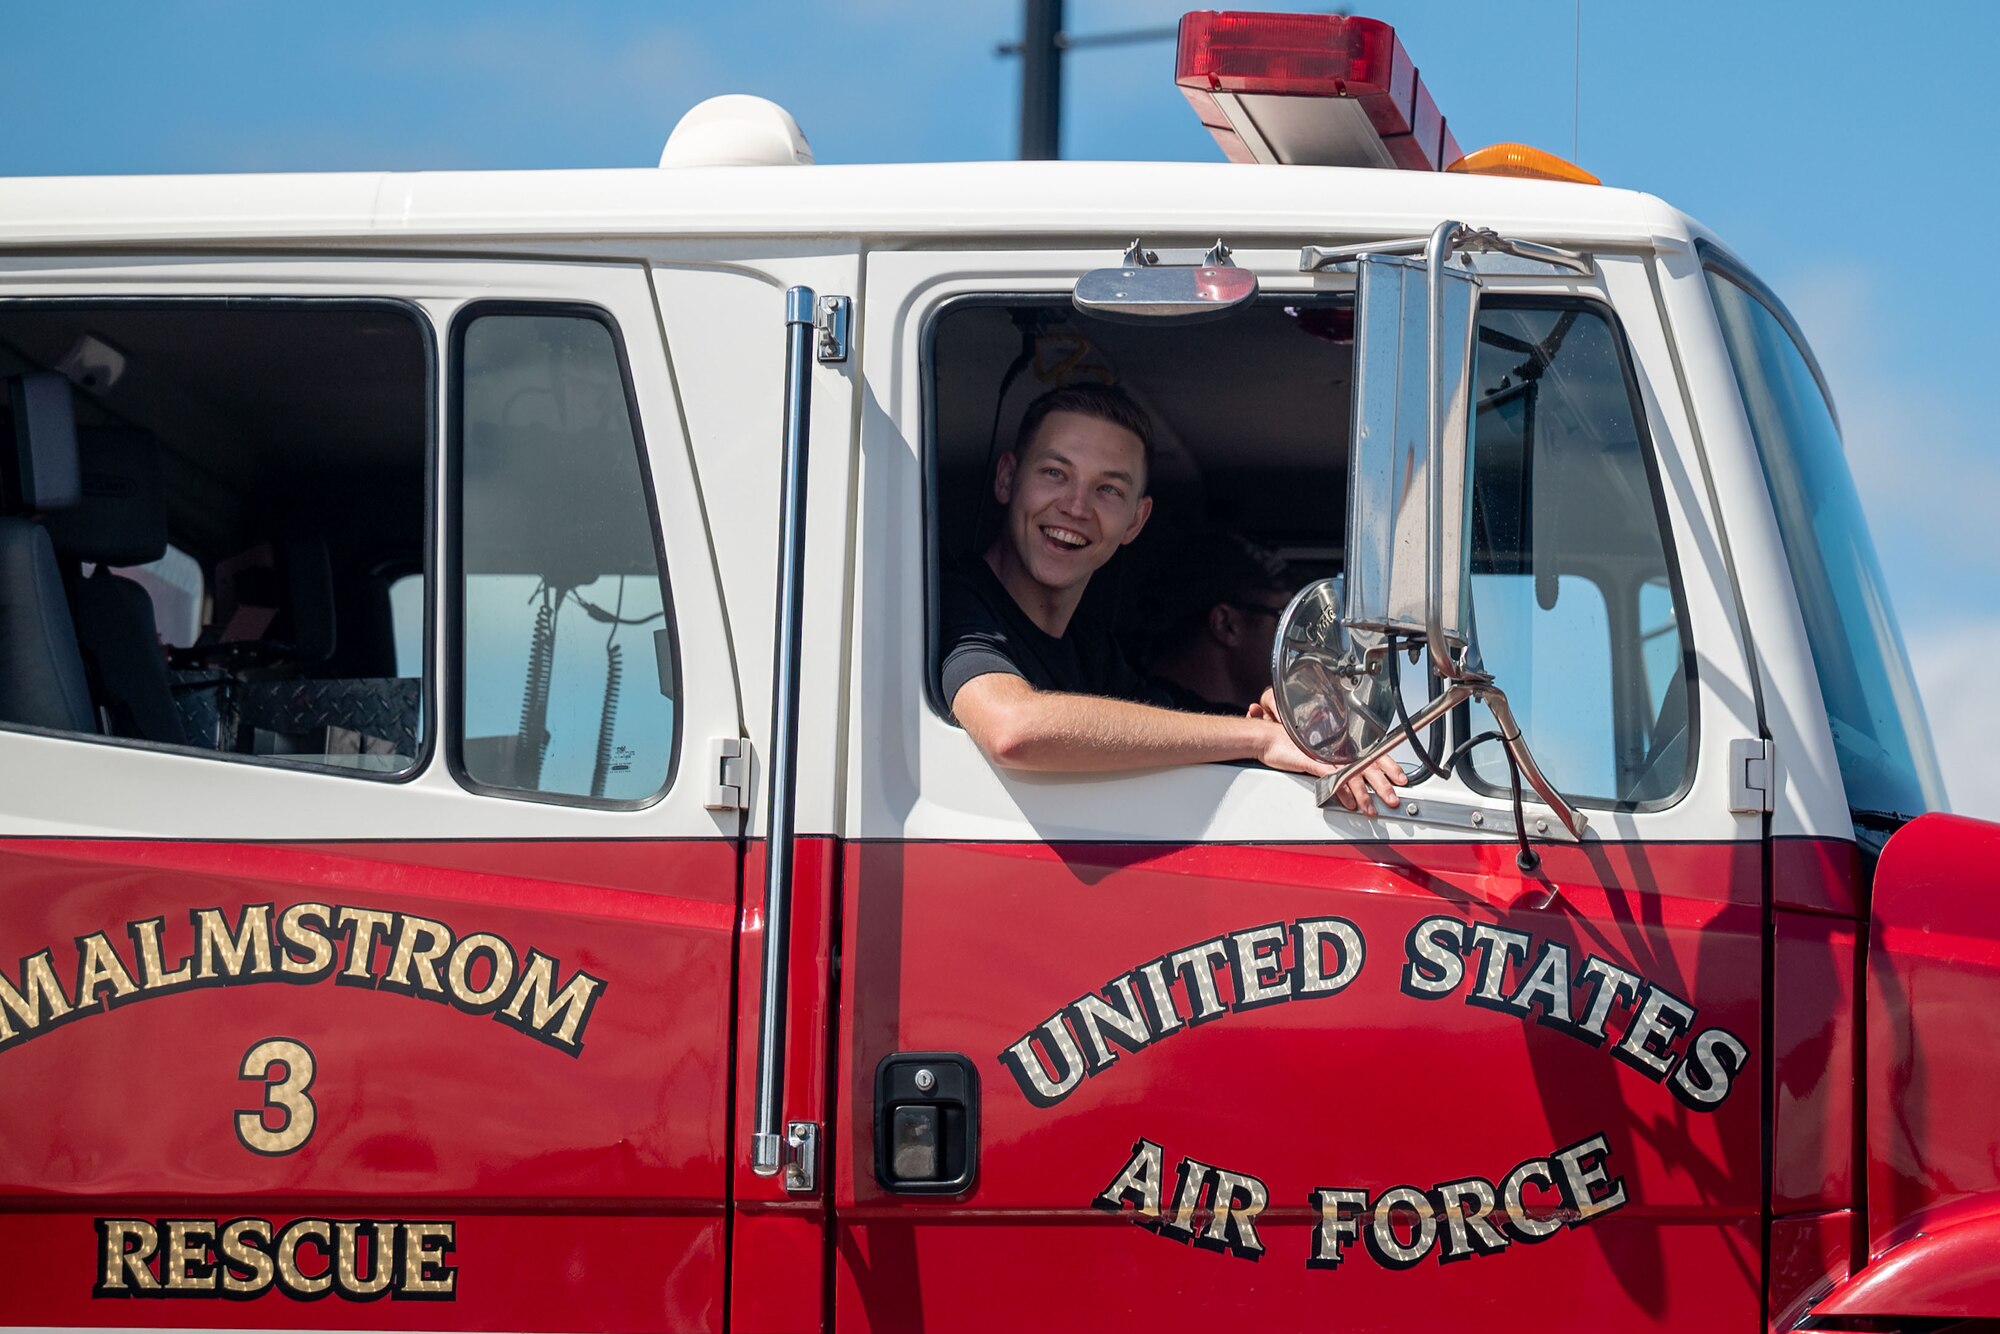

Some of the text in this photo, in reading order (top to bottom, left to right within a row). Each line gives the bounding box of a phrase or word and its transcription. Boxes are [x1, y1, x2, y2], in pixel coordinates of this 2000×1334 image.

[0, 902, 605, 1056] MALMSTROM
[999, 915, 1751, 1111] UNITED STATES
[234, 1037, 317, 1156] 3
[95, 1218, 456, 1300] RESCUE
[1092, 1132, 1627, 1269] AIR FORCE
